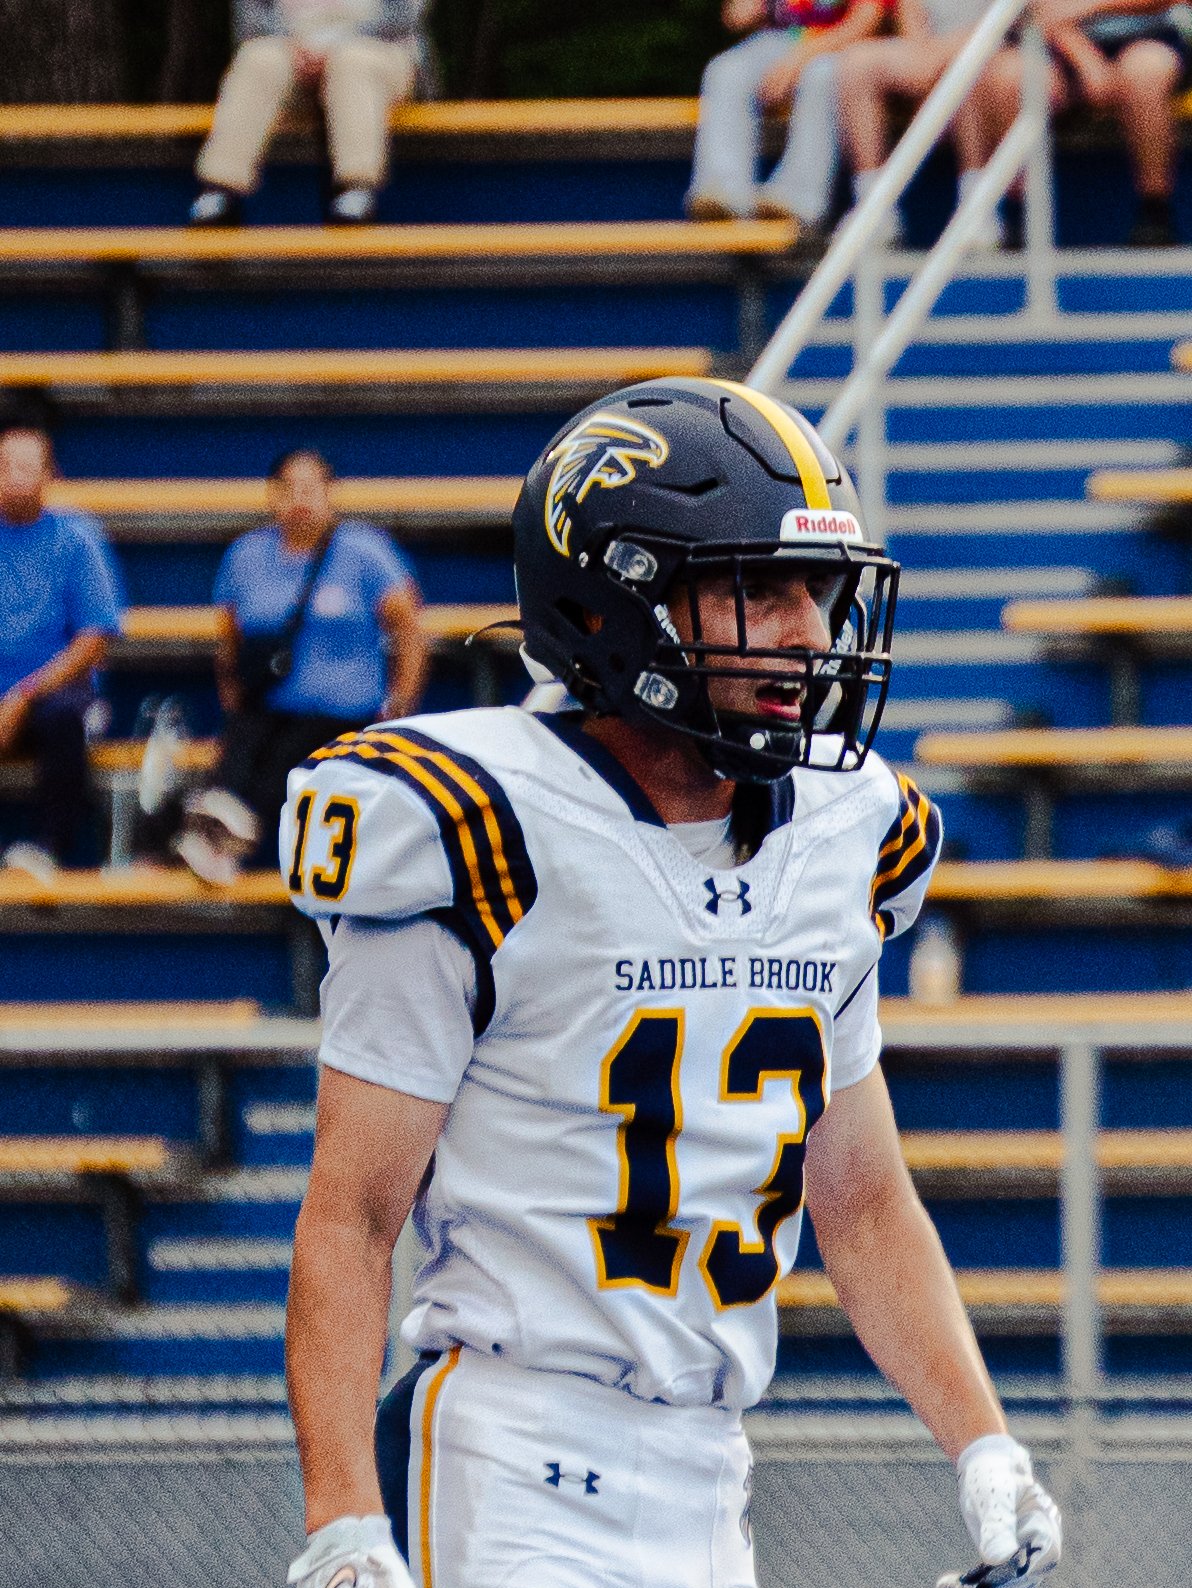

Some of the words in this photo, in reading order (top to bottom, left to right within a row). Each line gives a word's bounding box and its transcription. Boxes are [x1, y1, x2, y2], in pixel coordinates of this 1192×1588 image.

[796, 516, 856, 535] Riddell
[289, 790, 361, 902] 13
[615, 957, 737, 991] SADDLE
[749, 961, 836, 993] BROOK
[587, 1008, 830, 1312] 13
